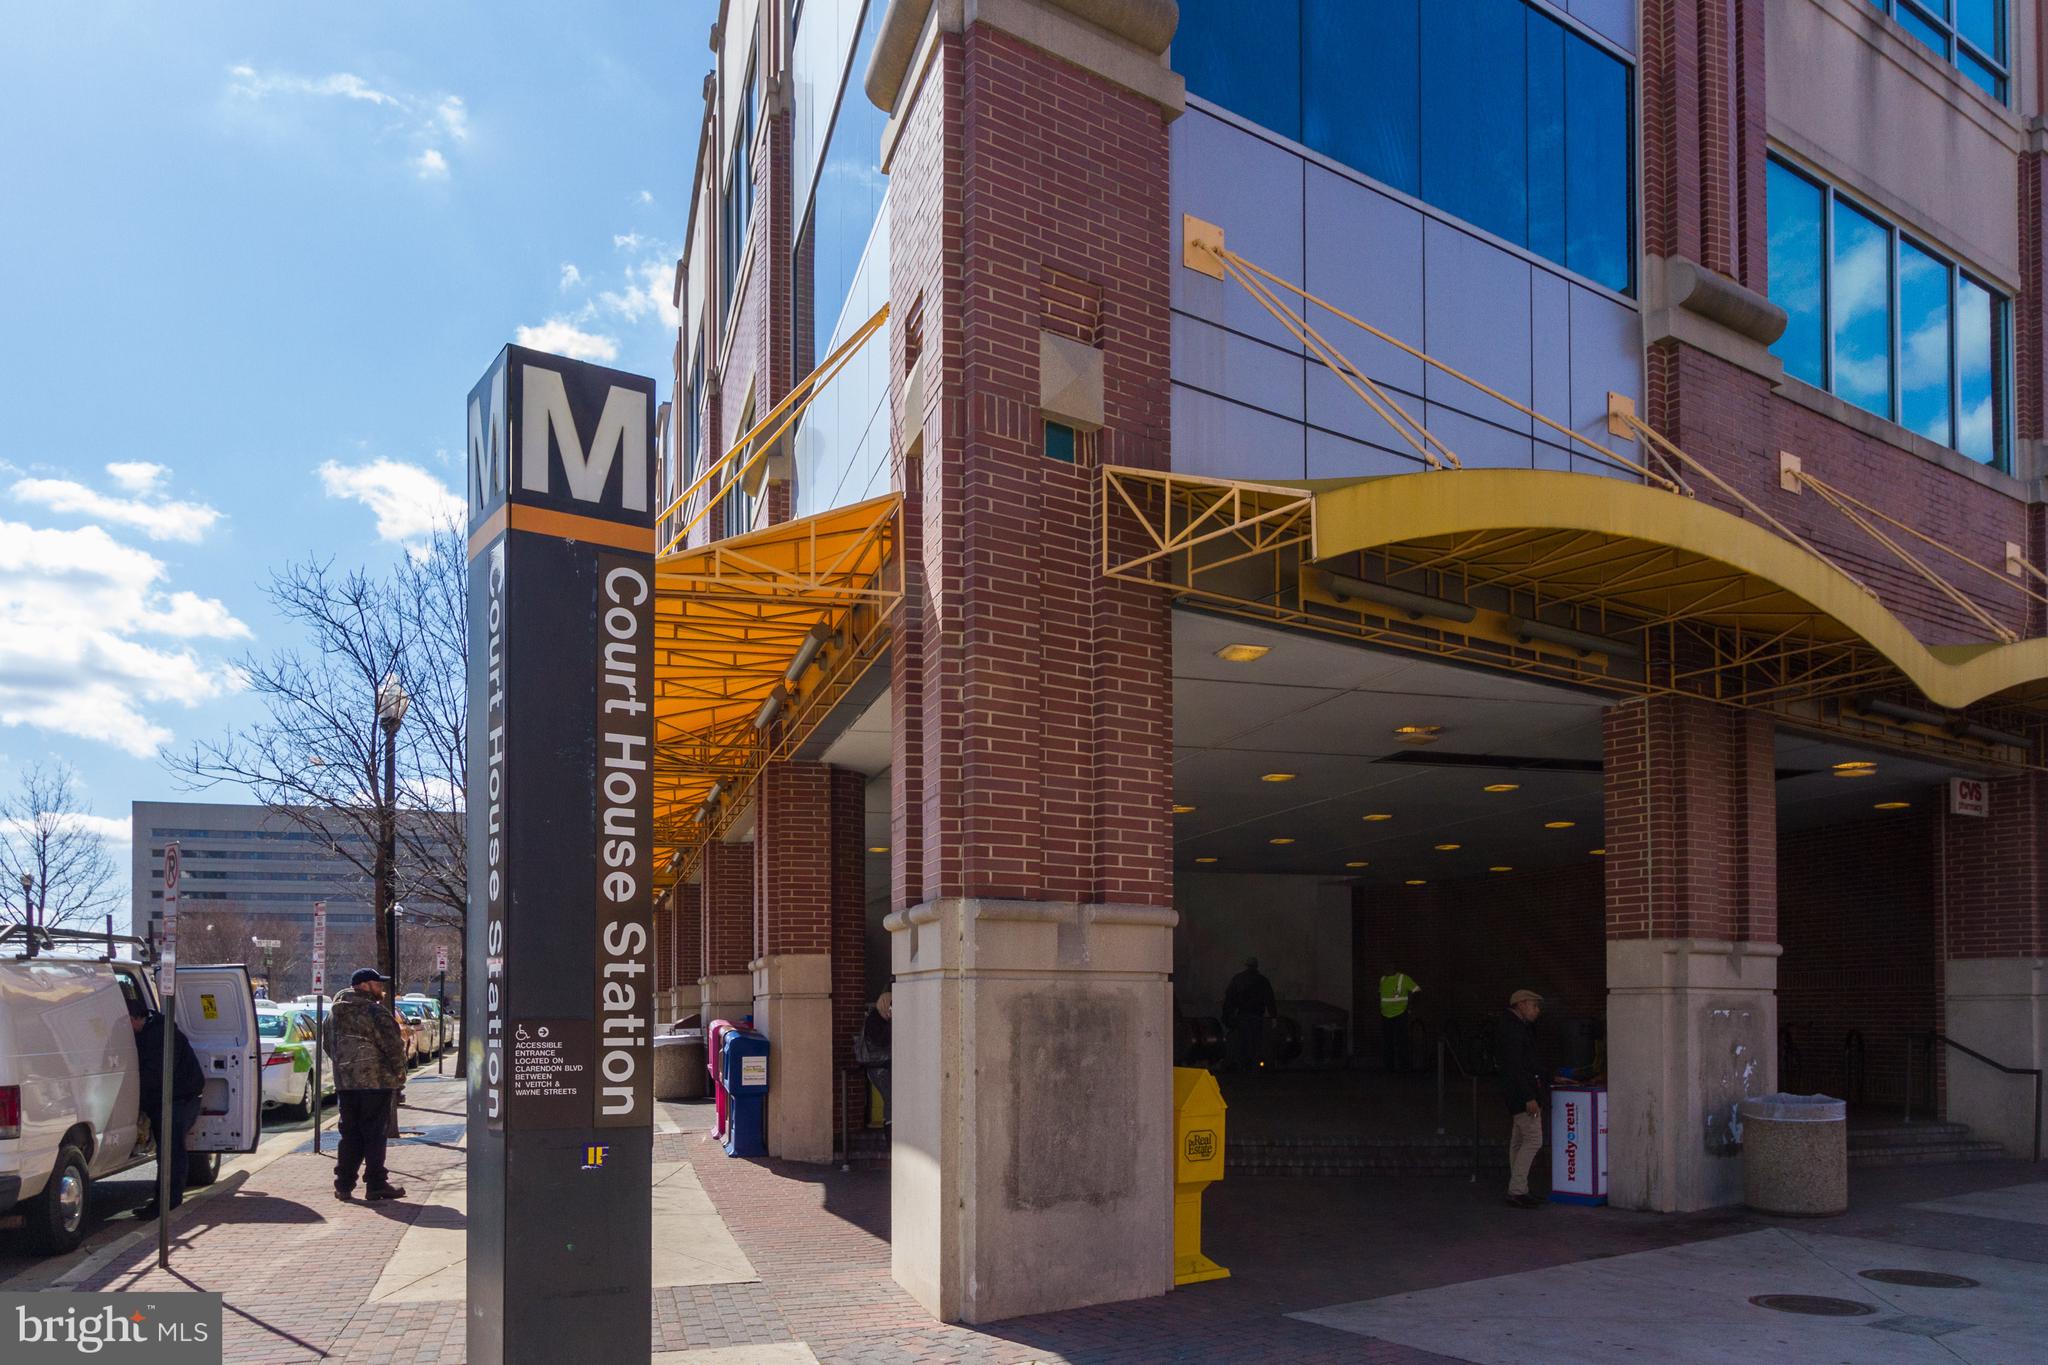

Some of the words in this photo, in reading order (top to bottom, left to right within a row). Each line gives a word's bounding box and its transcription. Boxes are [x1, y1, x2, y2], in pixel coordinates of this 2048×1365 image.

[469, 364, 505, 523] M
[521, 363, 648, 513] M
[489, 557, 503, 713] Court
[604, 566, 649, 717] Court
[489, 725, 503, 902] House
[602, 731, 647, 903] House
[1959, 780, 1982, 801] CVS
[487, 919, 503, 1119] Station
[515, 1065, 562, 1073] CLARENDON
[515, 1073, 552, 1081] BETWEEN
[602, 920, 647, 1116] Station
[1188, 1143, 1213, 1155] Estate
[1194, 1133, 1212, 1145] Real
